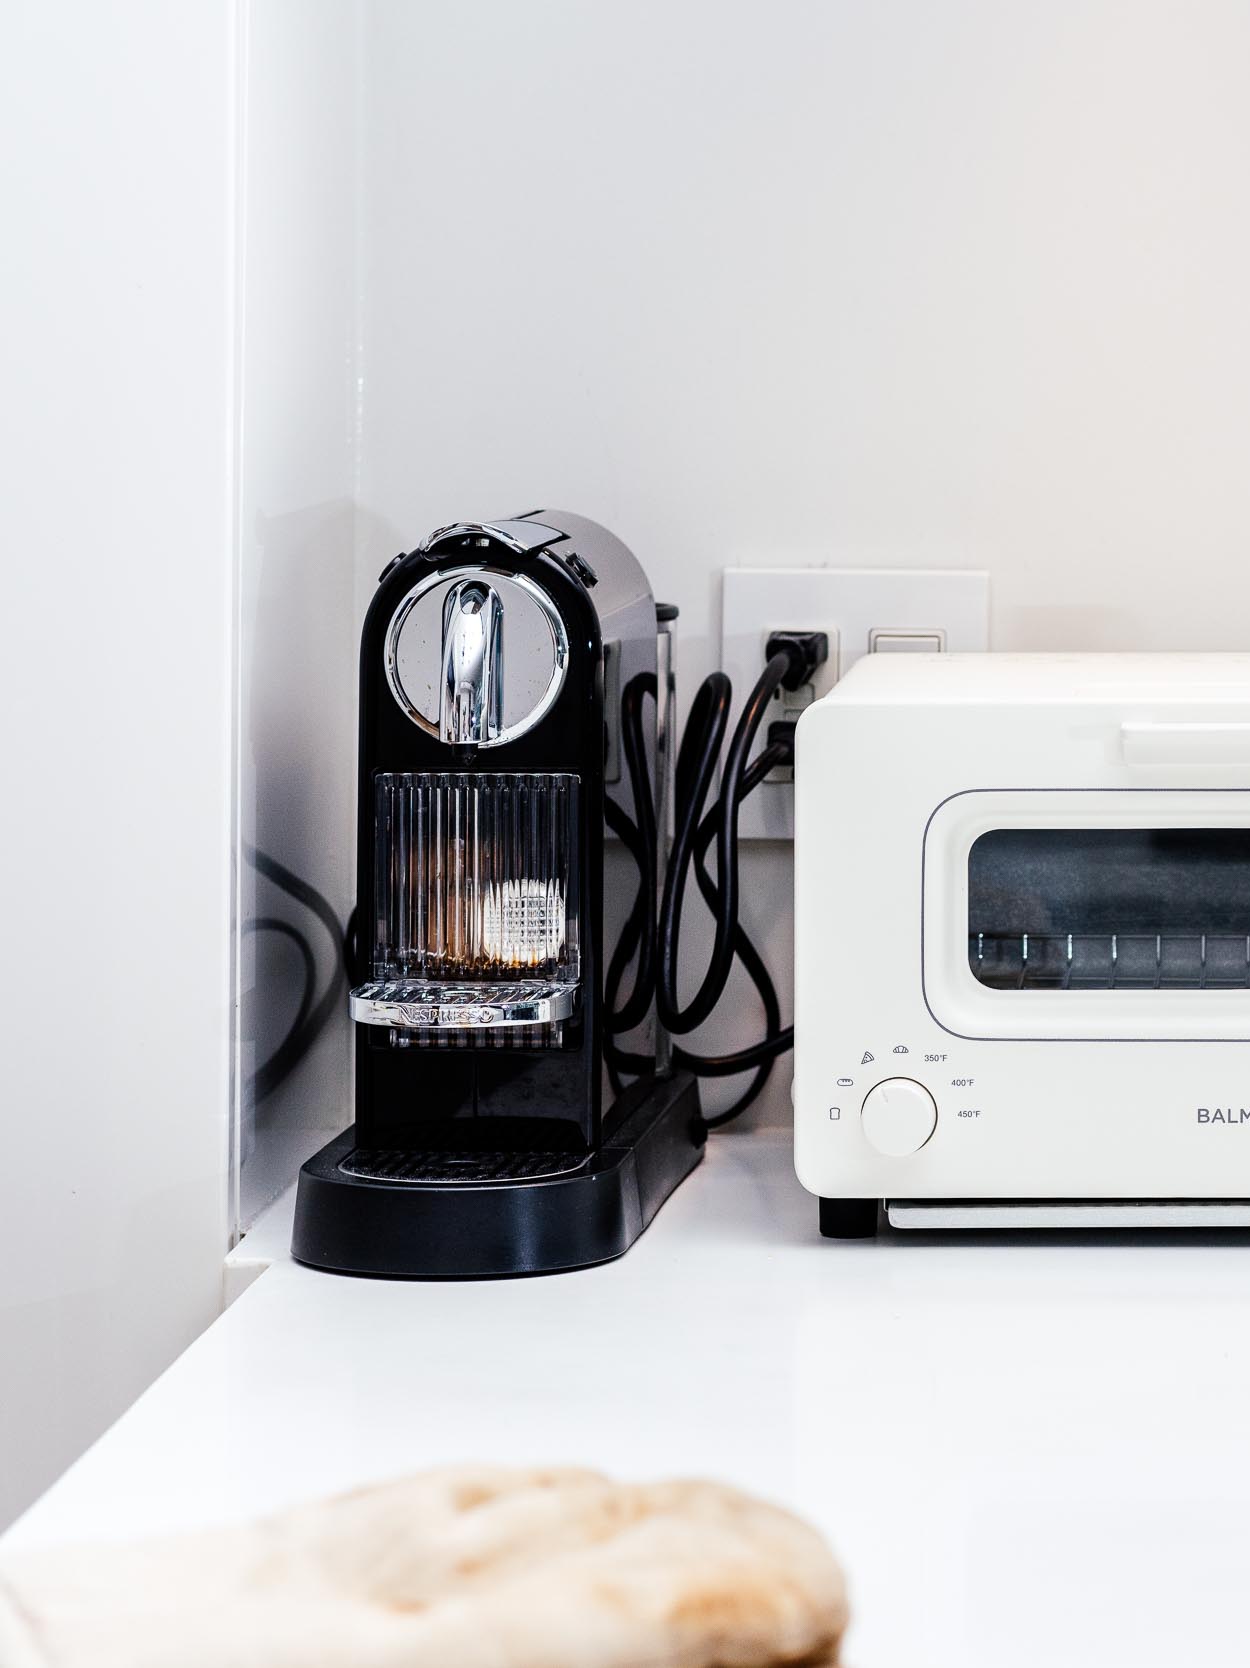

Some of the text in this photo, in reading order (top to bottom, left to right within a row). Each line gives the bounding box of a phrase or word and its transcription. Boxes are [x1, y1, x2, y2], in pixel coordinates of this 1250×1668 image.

[399, 1004, 494, 1024] NESPRESSO
[924, 1054, 948, 1062] 350°F
[951, 1079, 975, 1087] 400°F
[957, 1110, 981, 1118] 450°F
